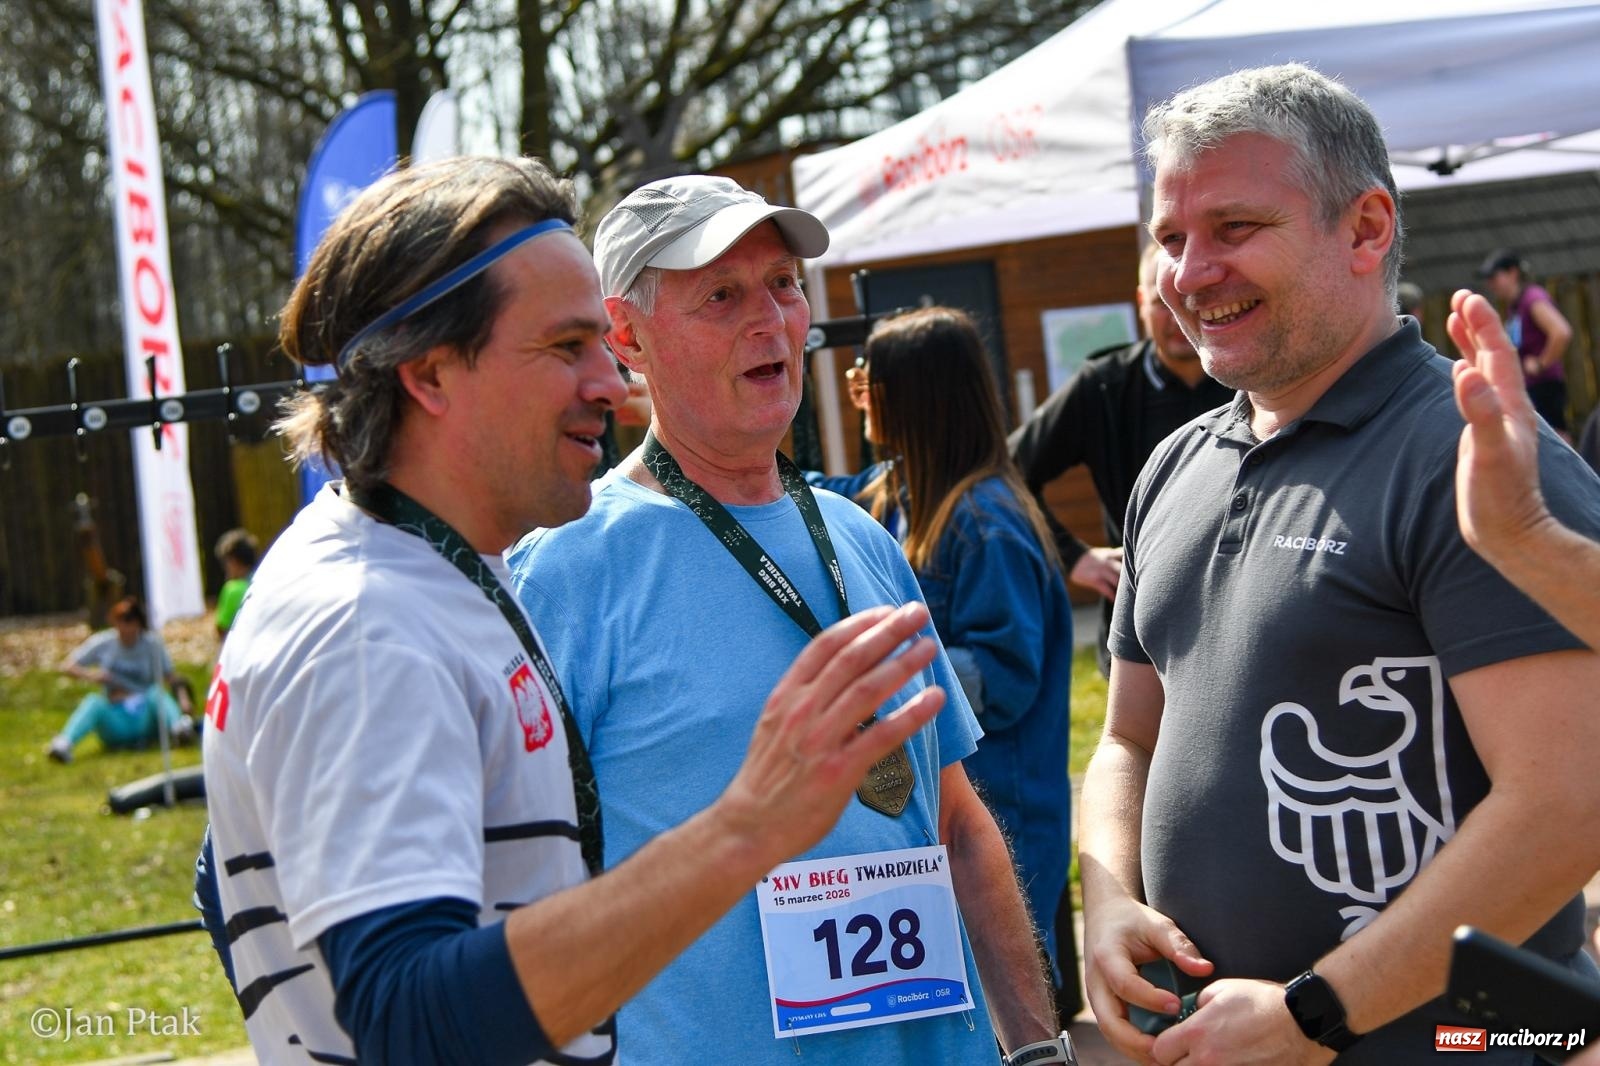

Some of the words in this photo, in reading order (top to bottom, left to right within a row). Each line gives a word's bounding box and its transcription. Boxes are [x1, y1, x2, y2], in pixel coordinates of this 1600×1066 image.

[1273, 535, 1348, 555] RACIBÓRZ
[758, 569, 776, 589] BIEG
[759, 555, 802, 607] TWARDZIELA
[773, 588, 790, 604] XIV
[771, 872, 802, 892] XIV
[809, 868, 850, 888] BIEG
[854, 858, 940, 882] TWARDZIELA
[774, 896, 786, 906] 15
[787, 894, 824, 906] marzec
[825, 888, 851, 900] 2026
[813, 908, 926, 980] 128
[897, 990, 930, 1004] Racibórz
[935, 987, 951, 998] OSiR
